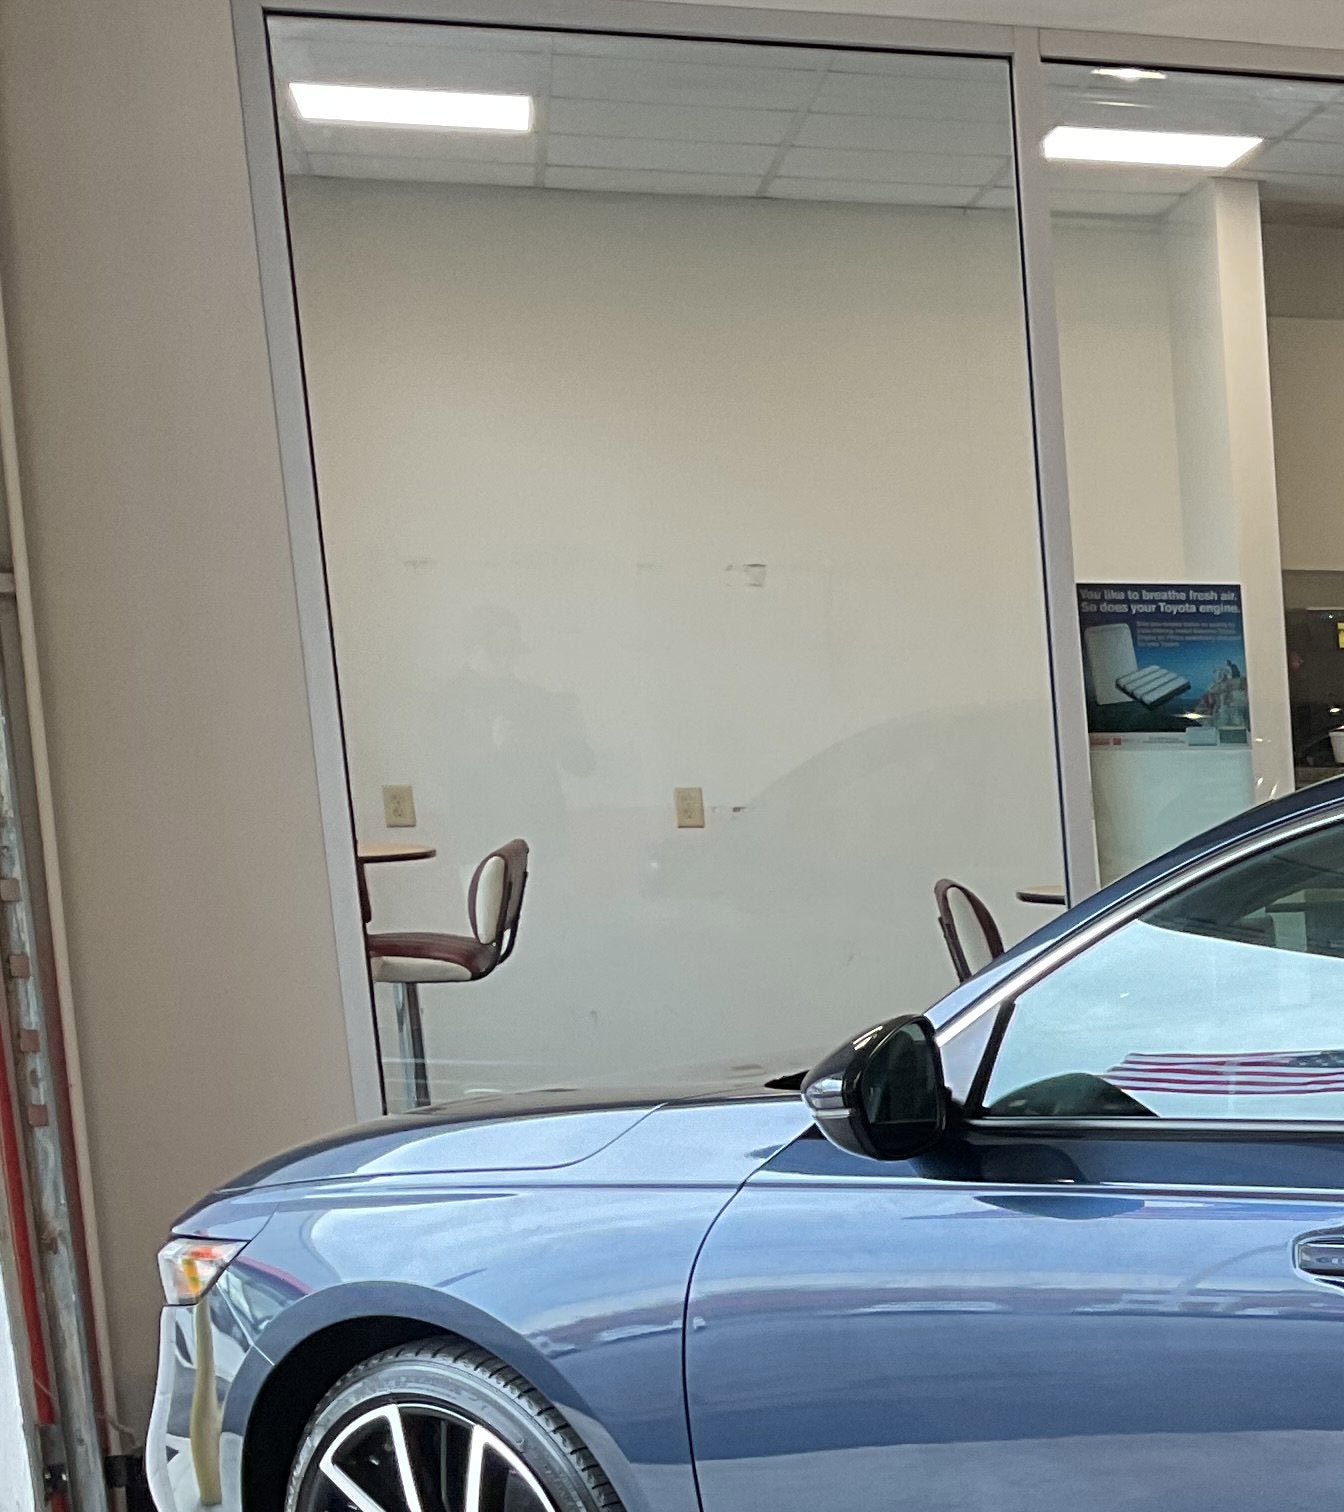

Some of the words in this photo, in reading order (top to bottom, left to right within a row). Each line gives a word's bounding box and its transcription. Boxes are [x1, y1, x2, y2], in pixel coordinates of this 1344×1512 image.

[1079, 589, 1101, 600] You
[1104, 589, 1125, 600] like
[1127, 590, 1139, 600] to
[1142, 589, 1186, 601] breathe
[1189, 590, 1218, 601] fresh
[1221, 592, 1238, 601] air.
[1080, 602, 1098, 613] So
[1100, 602, 1129, 613] does
[1131, 604, 1156, 615] your
[1159, 602, 1196, 615] Toyota
[1199, 603, 1240, 615] engine.
